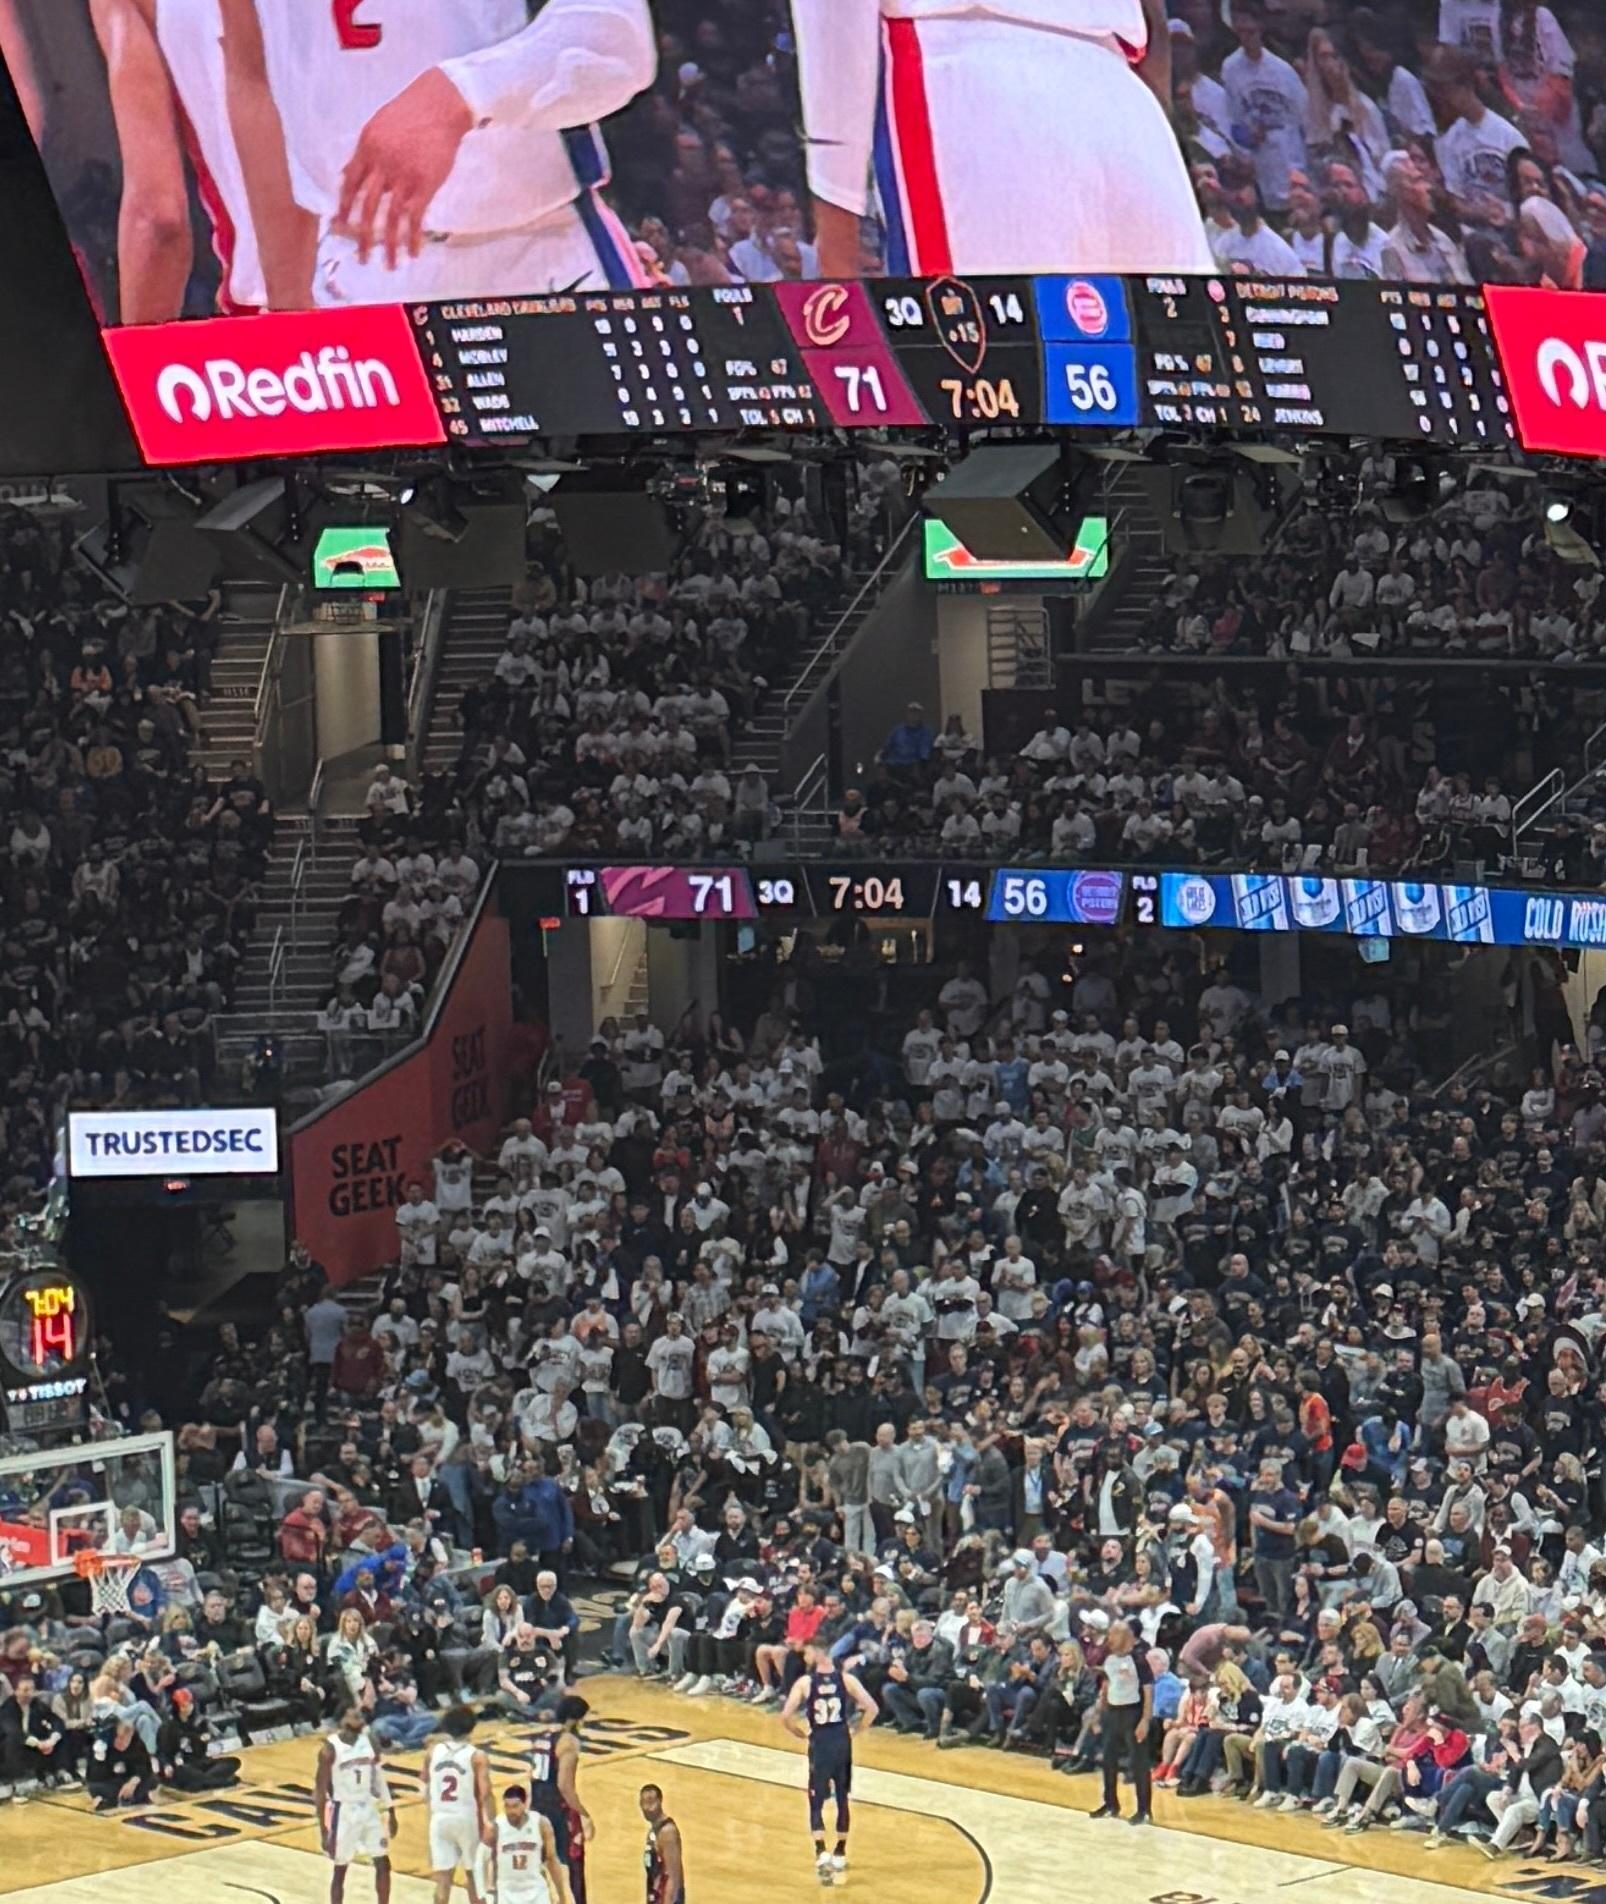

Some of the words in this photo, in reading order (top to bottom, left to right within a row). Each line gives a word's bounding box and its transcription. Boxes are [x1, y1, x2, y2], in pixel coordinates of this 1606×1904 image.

[988, 293, 1025, 326] 14
[210, 345, 401, 417] Redfin
[833, 365, 888, 412] 71
[940, 378, 1020, 419] 7:04
[1065, 363, 1117, 411] 56
[575, 888, 590, 915] 1
[688, 875, 734, 914] 71
[758, 879, 795, 905] 3Q
[828, 876, 905, 910] 7:04
[946, 879, 982, 909] 14
[1003, 878, 1048, 916] 56
[1136, 897, 1155, 924] 2
[1524, 897, 1563, 941] COLD
[85, 1128, 264, 1157] TRUSTEDSEC
[330, 1135, 403, 1179] SEAT
[328, 1170, 406, 1218] GEEK
[24, 1286, 75, 1317] 7:04
[33, 1313, 74, 1366] 14
[27, 1377, 88, 1401] TISSOT
[813, 1696, 843, 1725] 32
[439, 1774, 460, 1802] 2
